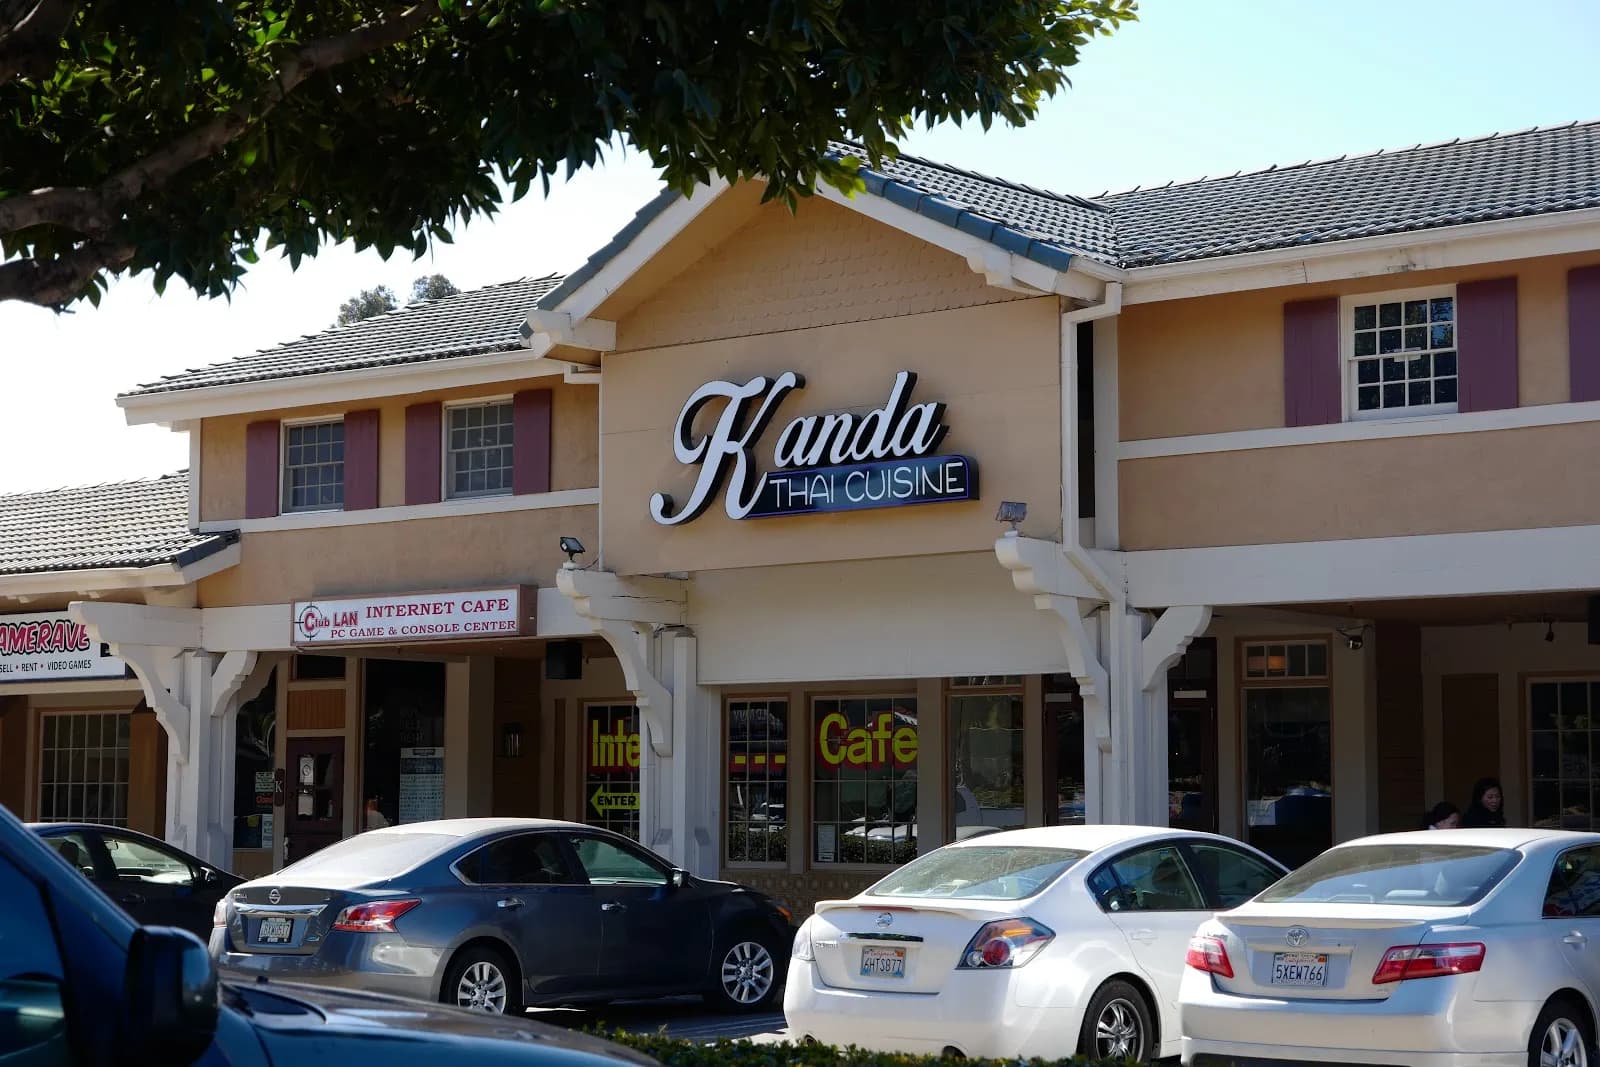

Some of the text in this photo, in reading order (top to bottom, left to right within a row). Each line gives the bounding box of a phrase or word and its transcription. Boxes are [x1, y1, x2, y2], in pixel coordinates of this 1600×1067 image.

[650, 371, 946, 525] Kanda
[769, 461, 965, 508] THAI CUISINE
[366, 598, 509, 619] INTERNET CAFE
[304, 611, 358, 632] Club LAN
[331, 620, 516, 639] PC GAME & CONSOLE CENTER
[21, 662, 38, 672] RENT
[48, 661, 67, 671] VIDEO
[68, 659, 92, 670] GAMES
[819, 712, 918, 765] Cafe
[275, 781, 283, 793] K
[597, 795, 636, 806] ENTER
[1276, 964, 1323, 981] 5XEW766
